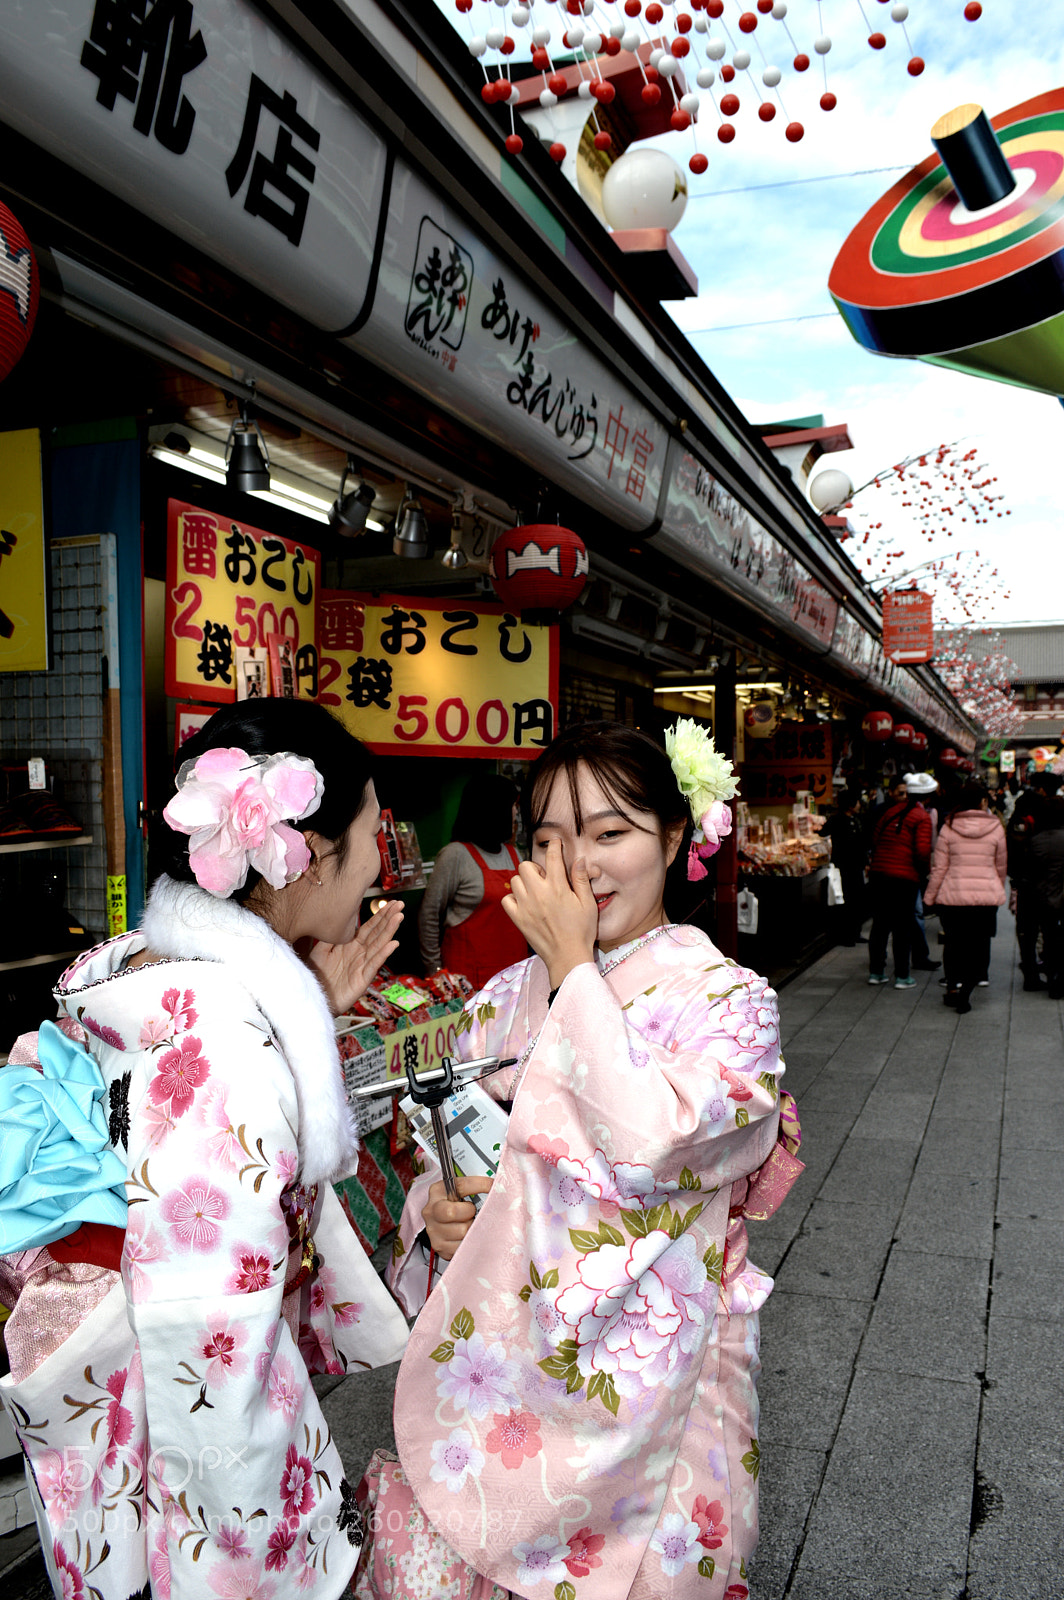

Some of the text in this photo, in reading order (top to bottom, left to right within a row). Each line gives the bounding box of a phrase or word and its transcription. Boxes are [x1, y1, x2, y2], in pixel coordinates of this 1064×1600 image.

[603, 405, 654, 503] 中富
[182, 512, 313, 605] 雷おこし
[320, 599, 532, 663] 雷おこし
[393, 695, 553, 747] 500円
